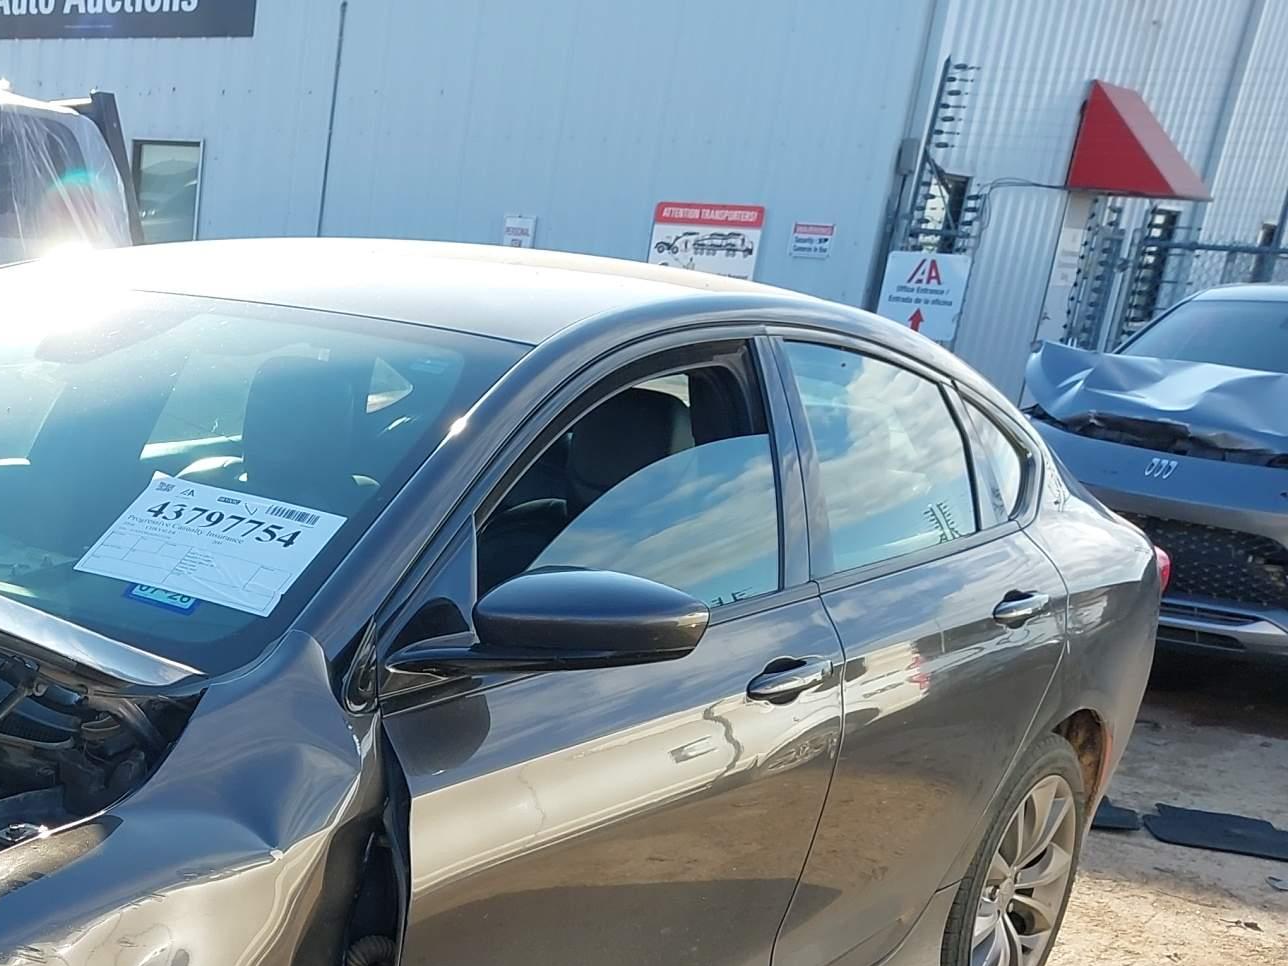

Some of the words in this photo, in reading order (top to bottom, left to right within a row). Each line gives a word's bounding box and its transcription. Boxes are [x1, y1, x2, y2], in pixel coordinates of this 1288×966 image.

[662, 207, 700, 219] ATTENTION
[128, 514, 172, 528] Progressive
[206, 530, 244, 544] Insurance
[147, 501, 303, 548] 43797754
